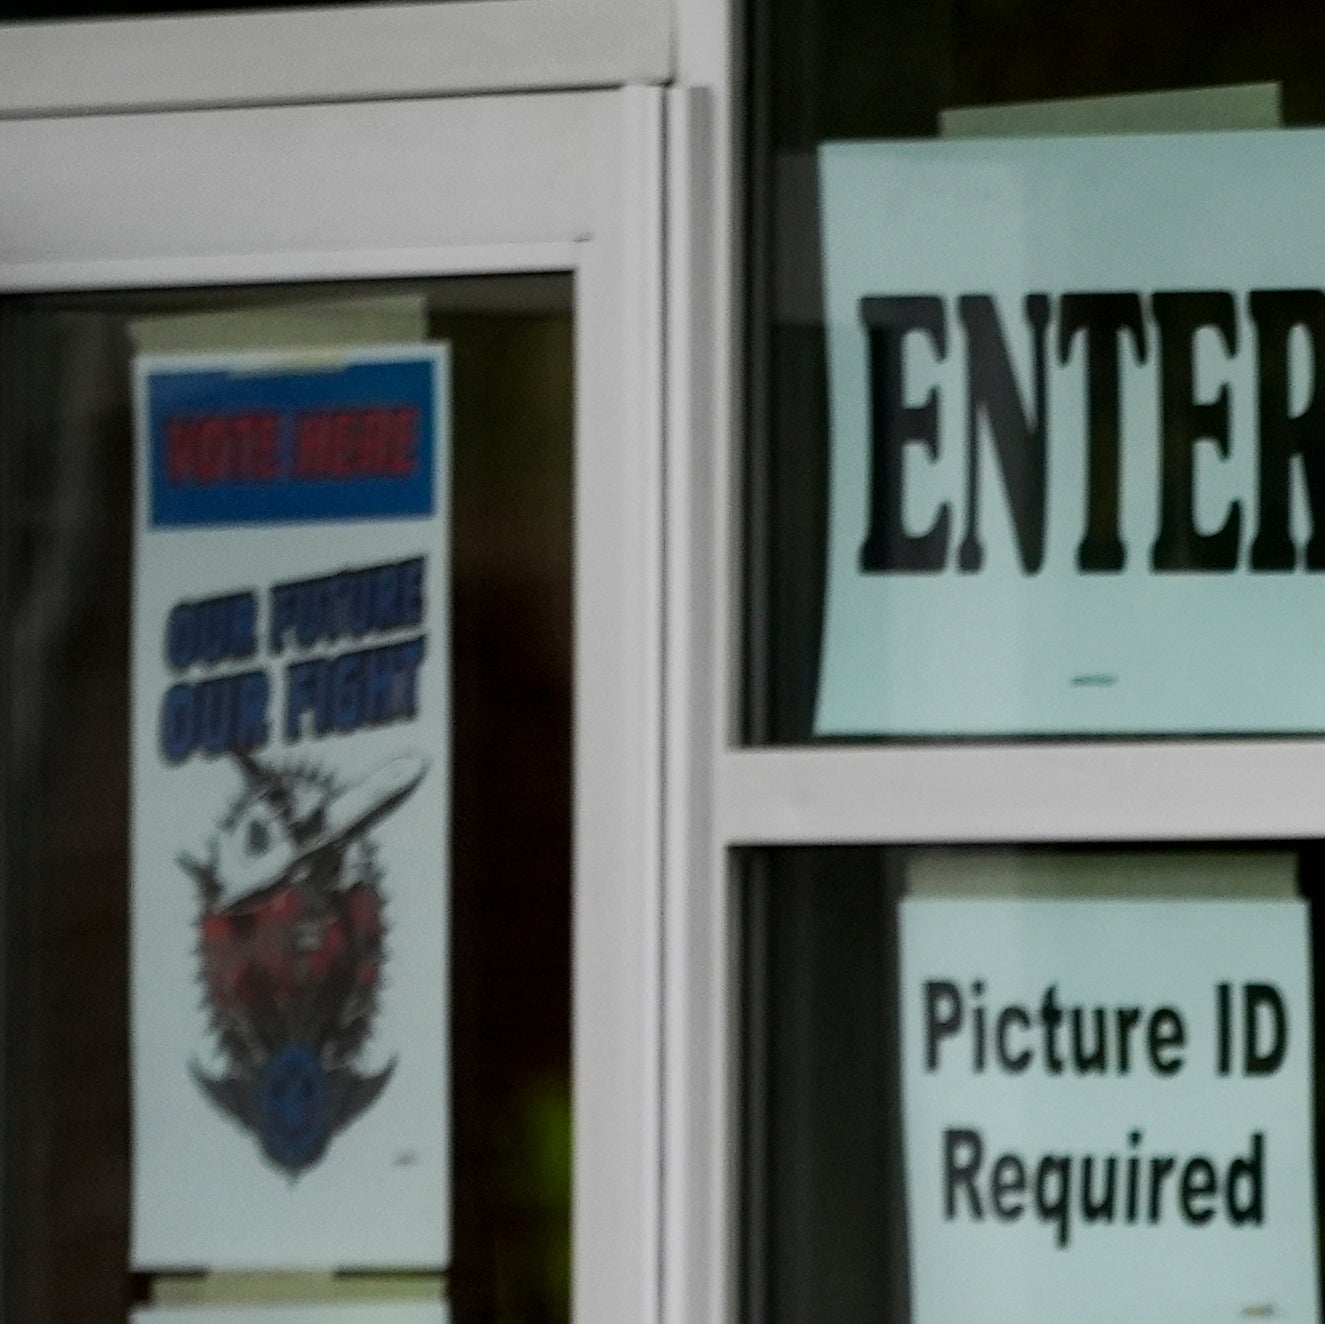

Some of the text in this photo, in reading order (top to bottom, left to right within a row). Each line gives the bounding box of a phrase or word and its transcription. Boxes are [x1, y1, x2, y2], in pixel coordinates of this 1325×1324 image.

[165, 406, 419, 484] VOTE HERE
[164, 555, 425, 674] OUR FUTURE
[159, 633, 425, 768] OUR FIGHT
[921, 976, 1290, 1077] Picture ID
[942, 1126, 1267, 1250] Required
